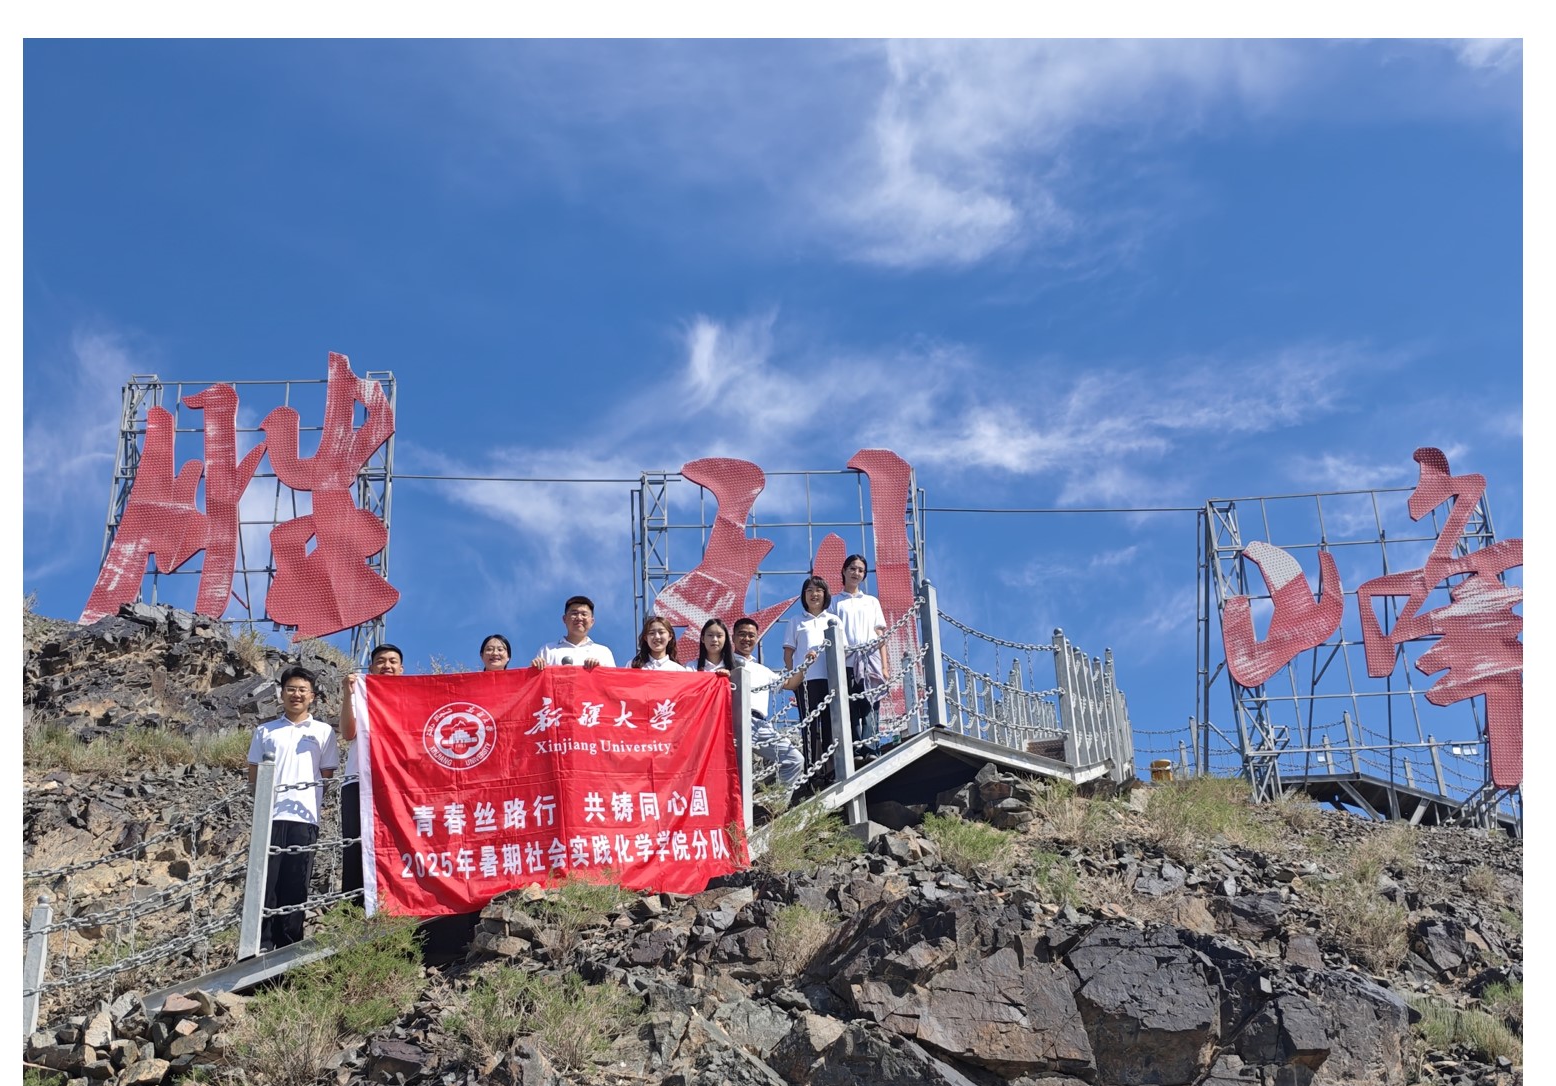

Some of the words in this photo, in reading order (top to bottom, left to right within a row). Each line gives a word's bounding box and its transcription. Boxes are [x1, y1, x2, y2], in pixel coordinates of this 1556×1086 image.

[465, 741, 492, 767] UNIVERSITY
[535, 738, 597, 755] Xinjiang
[600, 739, 672, 755] University
[412, 794, 557, 838] 青春丝路行
[583, 785, 710, 823] 共铸同心圆
[401, 829, 730, 880] 2025年暑期社会实践化学学院分队
